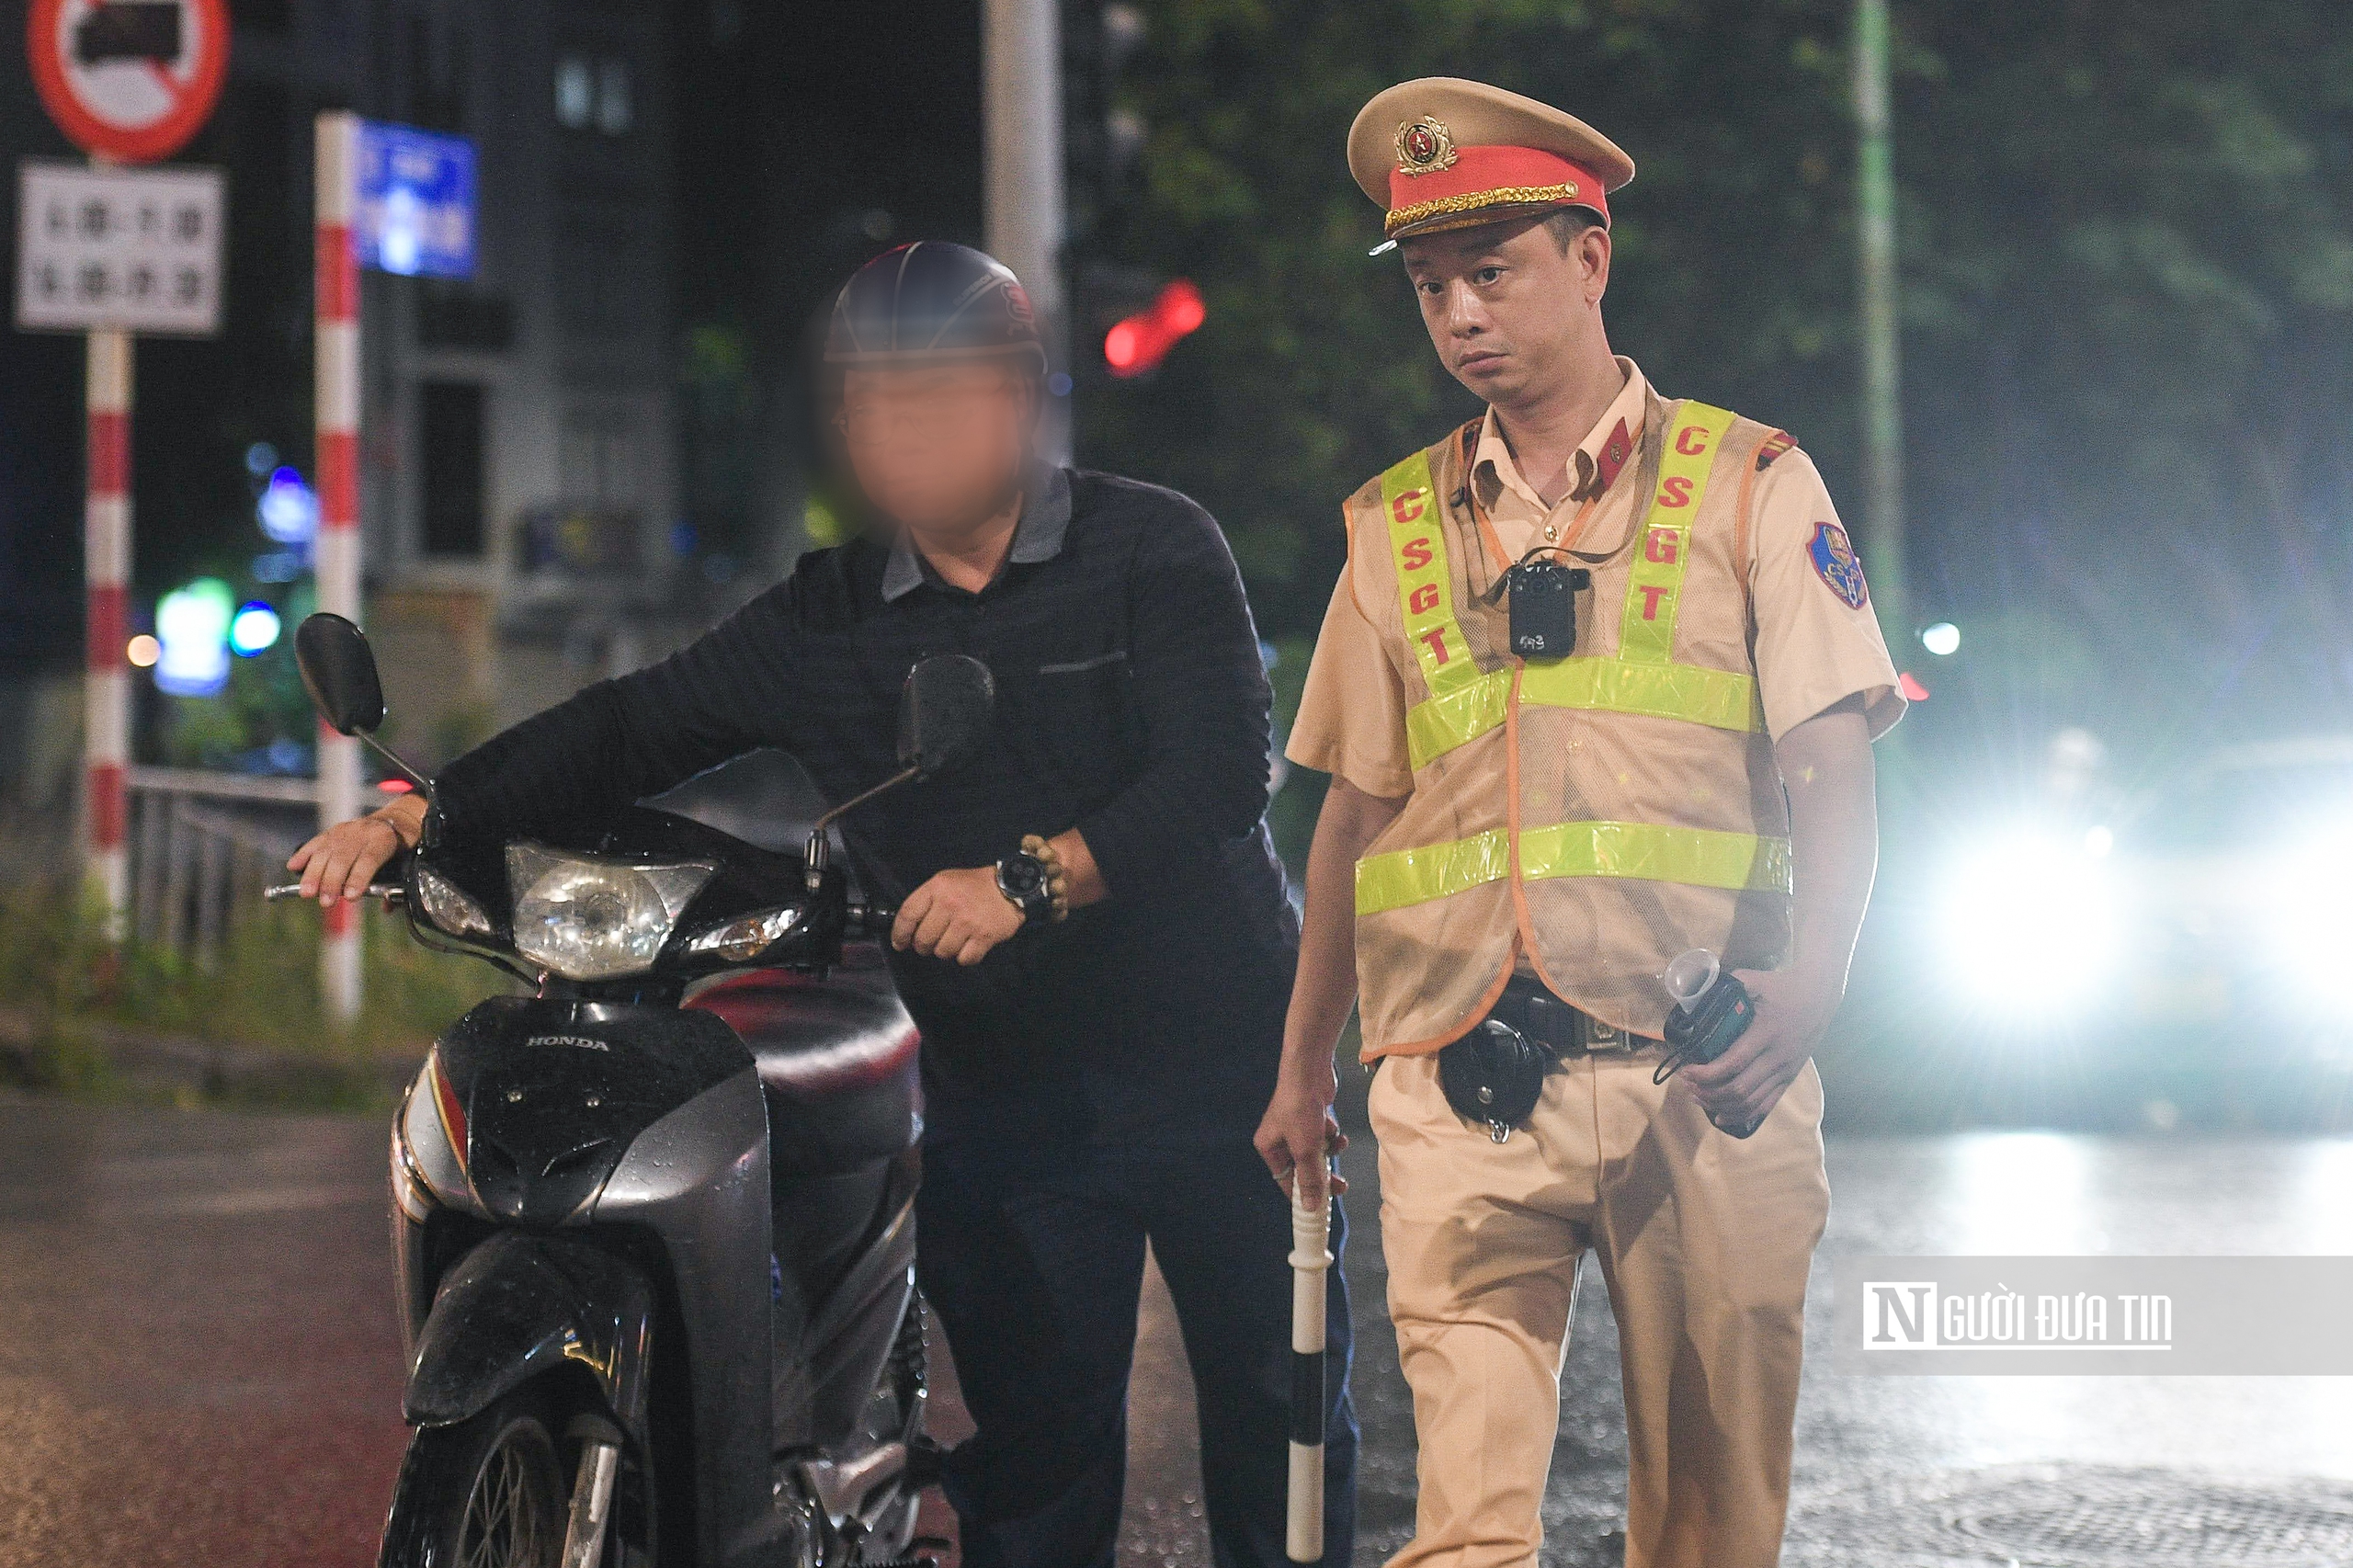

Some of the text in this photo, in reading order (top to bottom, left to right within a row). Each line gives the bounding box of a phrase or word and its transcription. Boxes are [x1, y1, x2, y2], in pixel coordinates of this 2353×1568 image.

[1392, 490, 1449, 665] CSGT
[1640, 426, 1710, 621] CSGT
[526, 1036, 609, 1052] HONDA
